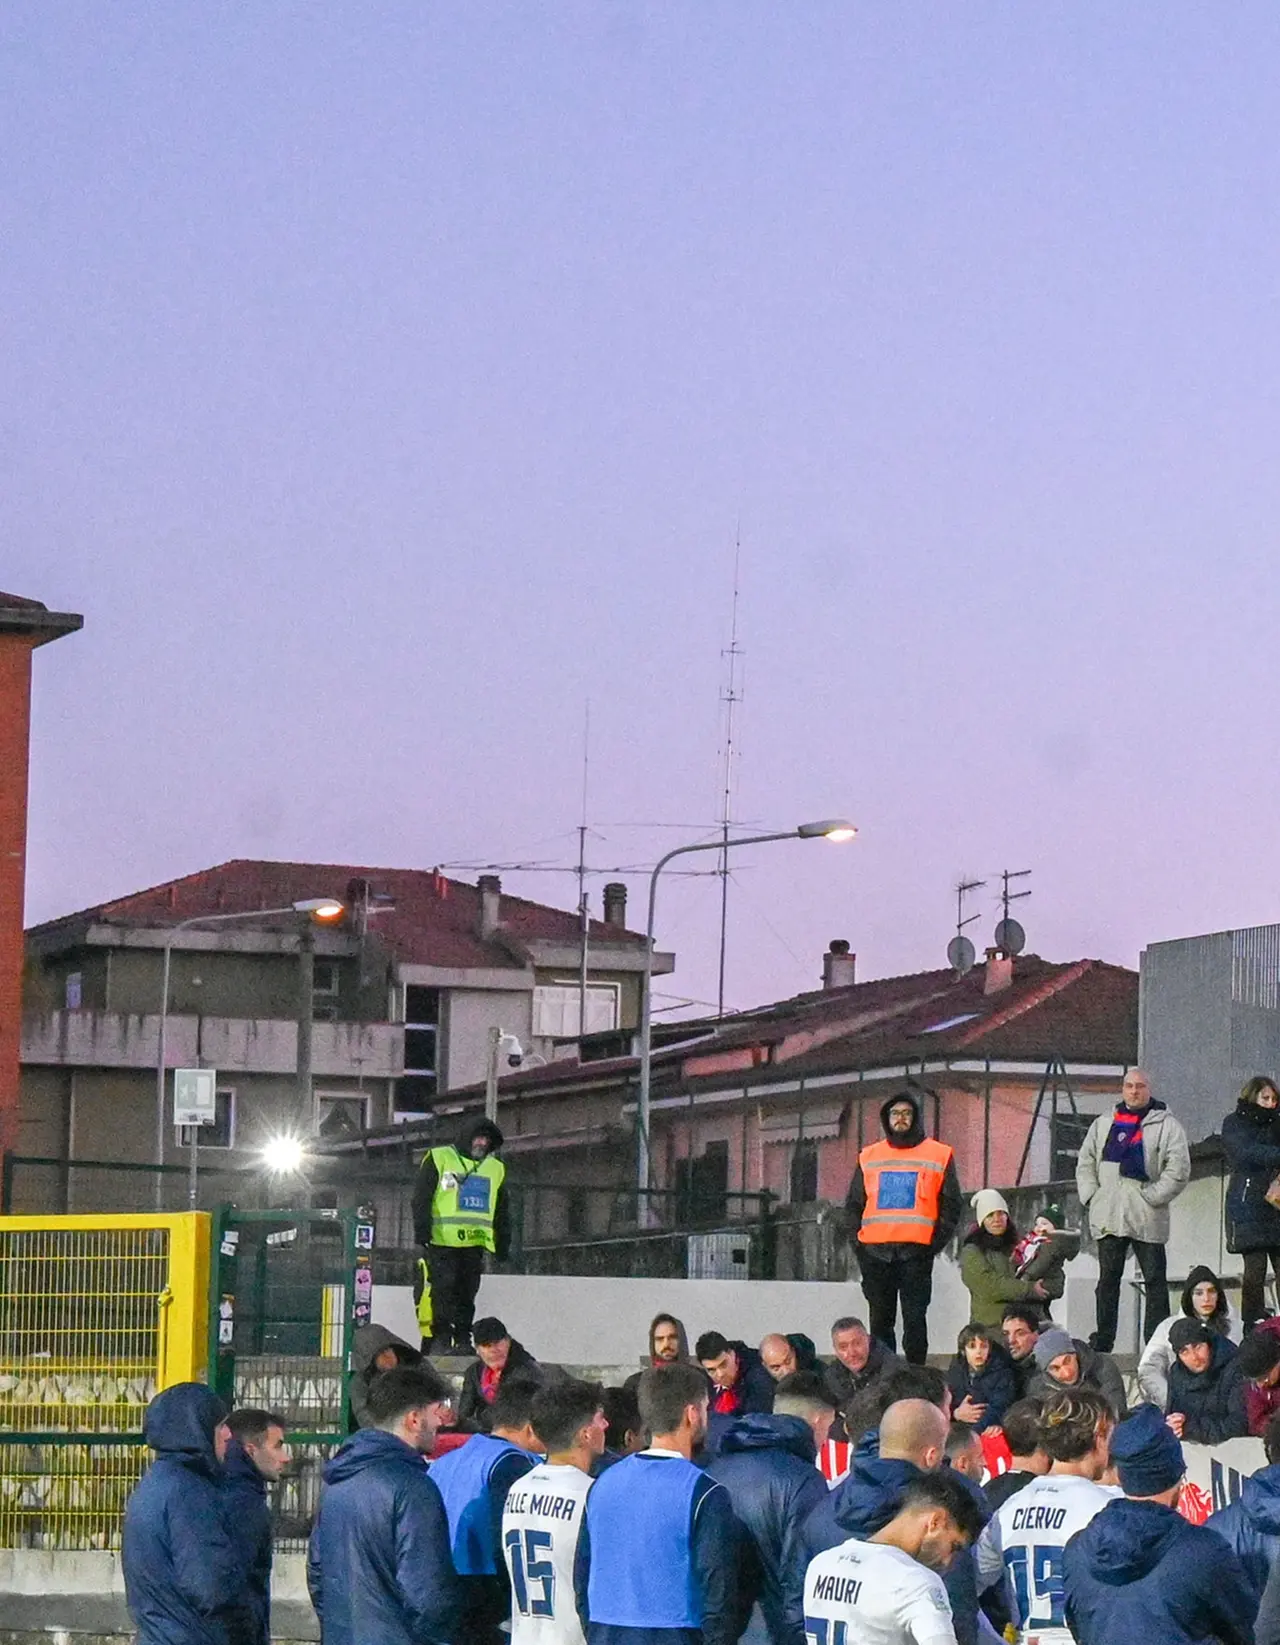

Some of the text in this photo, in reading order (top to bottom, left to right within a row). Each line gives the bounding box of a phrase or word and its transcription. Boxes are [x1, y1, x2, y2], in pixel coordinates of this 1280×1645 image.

[530, 1493, 576, 1522] MURA
[1012, 1506, 1067, 1530] CIERVO
[505, 1528, 556, 1621] 15
[813, 1574, 862, 1605] MAURI
